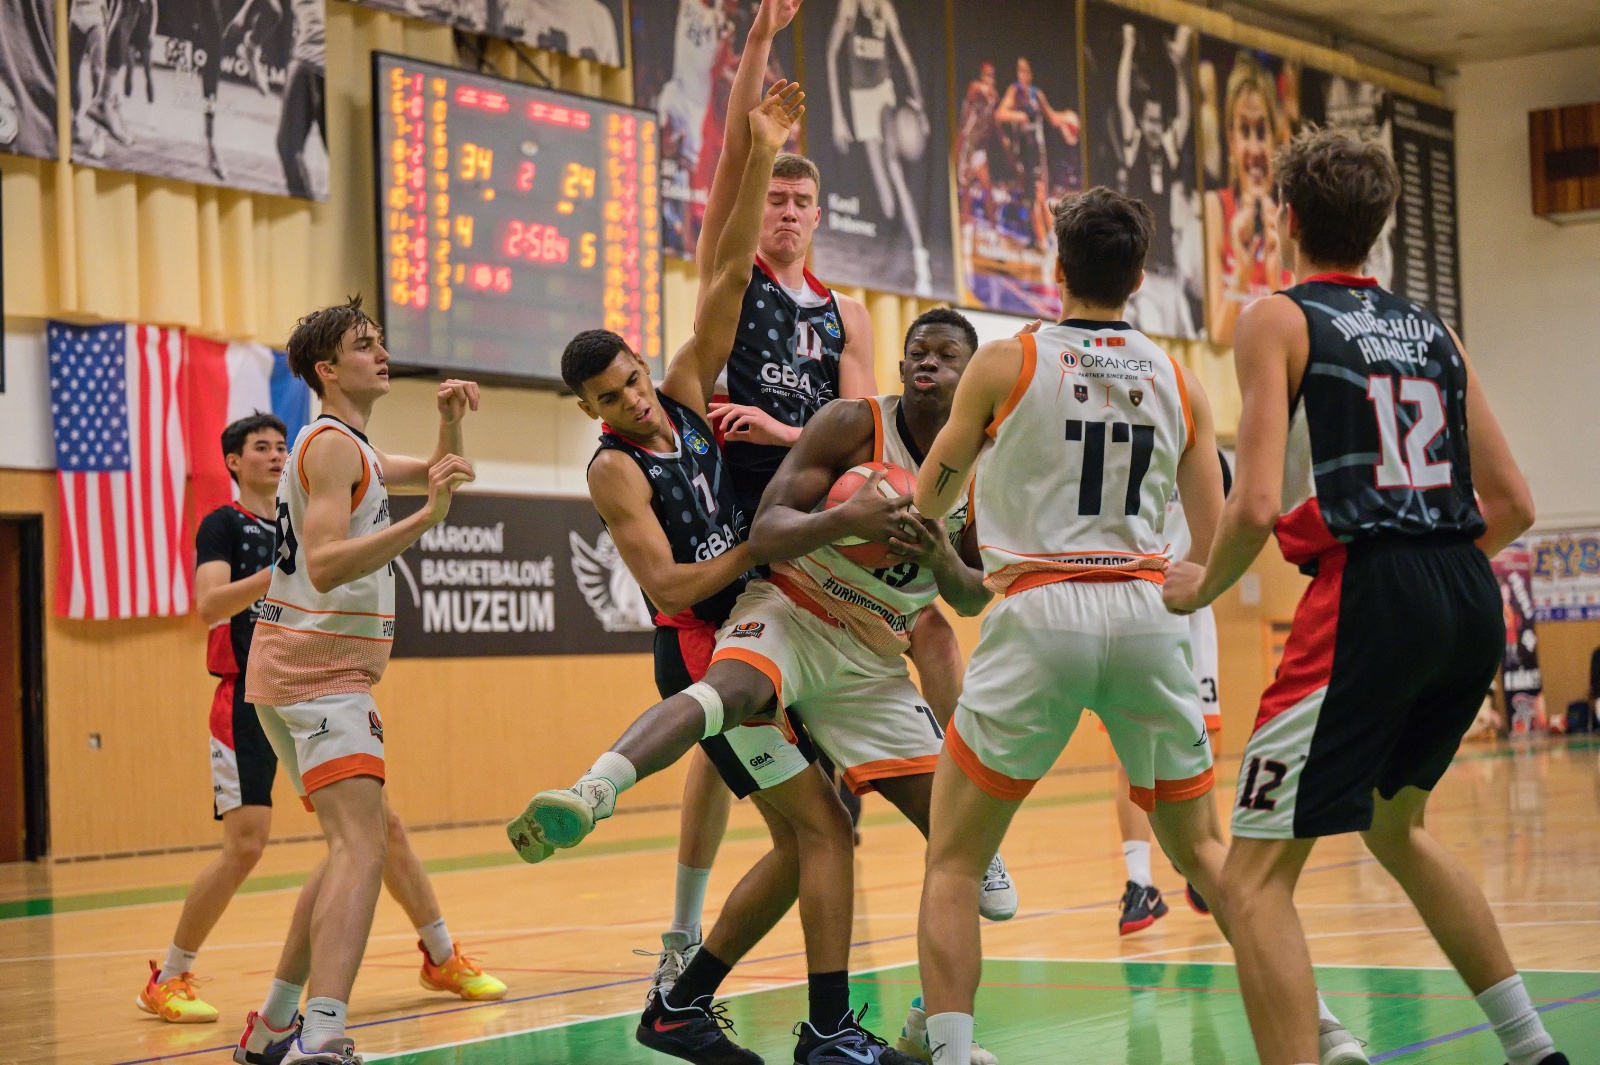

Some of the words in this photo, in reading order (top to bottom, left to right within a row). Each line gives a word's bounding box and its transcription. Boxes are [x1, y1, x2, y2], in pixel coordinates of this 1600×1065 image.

[461, 143, 493, 181] 34
[517, 161, 536, 191] 2
[564, 162, 596, 198] 24
[455, 215, 474, 248] 4
[580, 232, 597, 268] 5
[796, 320, 822, 361] 11
[1357, 336, 1428, 367] HRADEC
[761, 362, 812, 397] GBA
[1080, 353, 1153, 373] ORANGE1
[1366, 373, 1452, 491] 12
[420, 521, 505, 553] NÁRODNÍ
[695, 523, 735, 562] GBA
[420, 555, 555, 588] BASKETBALOVÉ
[422, 590, 555, 633] MUZEUM
[749, 752, 773, 767] GBA
[1238, 756, 1287, 812] 12
